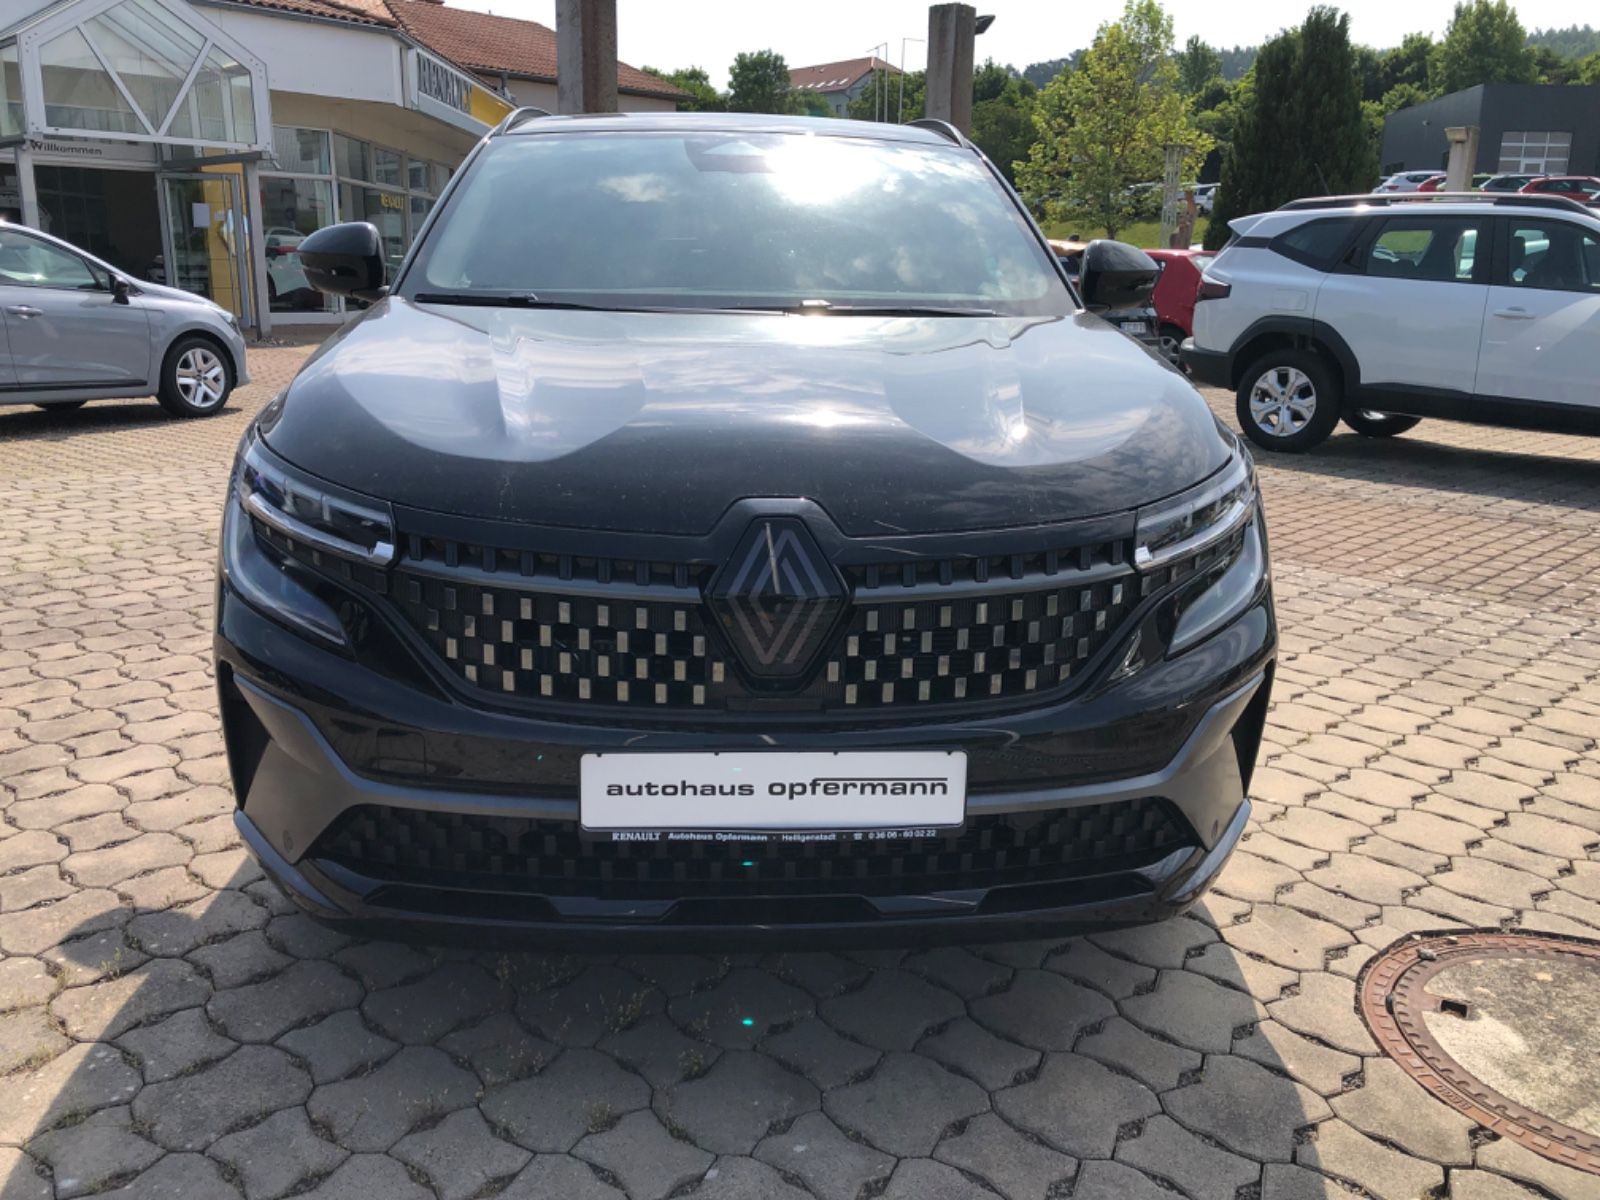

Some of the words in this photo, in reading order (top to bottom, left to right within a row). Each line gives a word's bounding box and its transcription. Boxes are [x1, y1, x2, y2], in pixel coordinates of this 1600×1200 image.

[30, 139, 103, 155] Willkommen
[606, 780, 755, 796] autohaus
[768, 777, 948, 800] opfermann
[612, 832, 661, 841] RENAULT
[668, 832, 714, 841] Autohaus
[715, 833, 768, 842] Opfermann
[782, 834, 836, 842] Heiligenstadt
